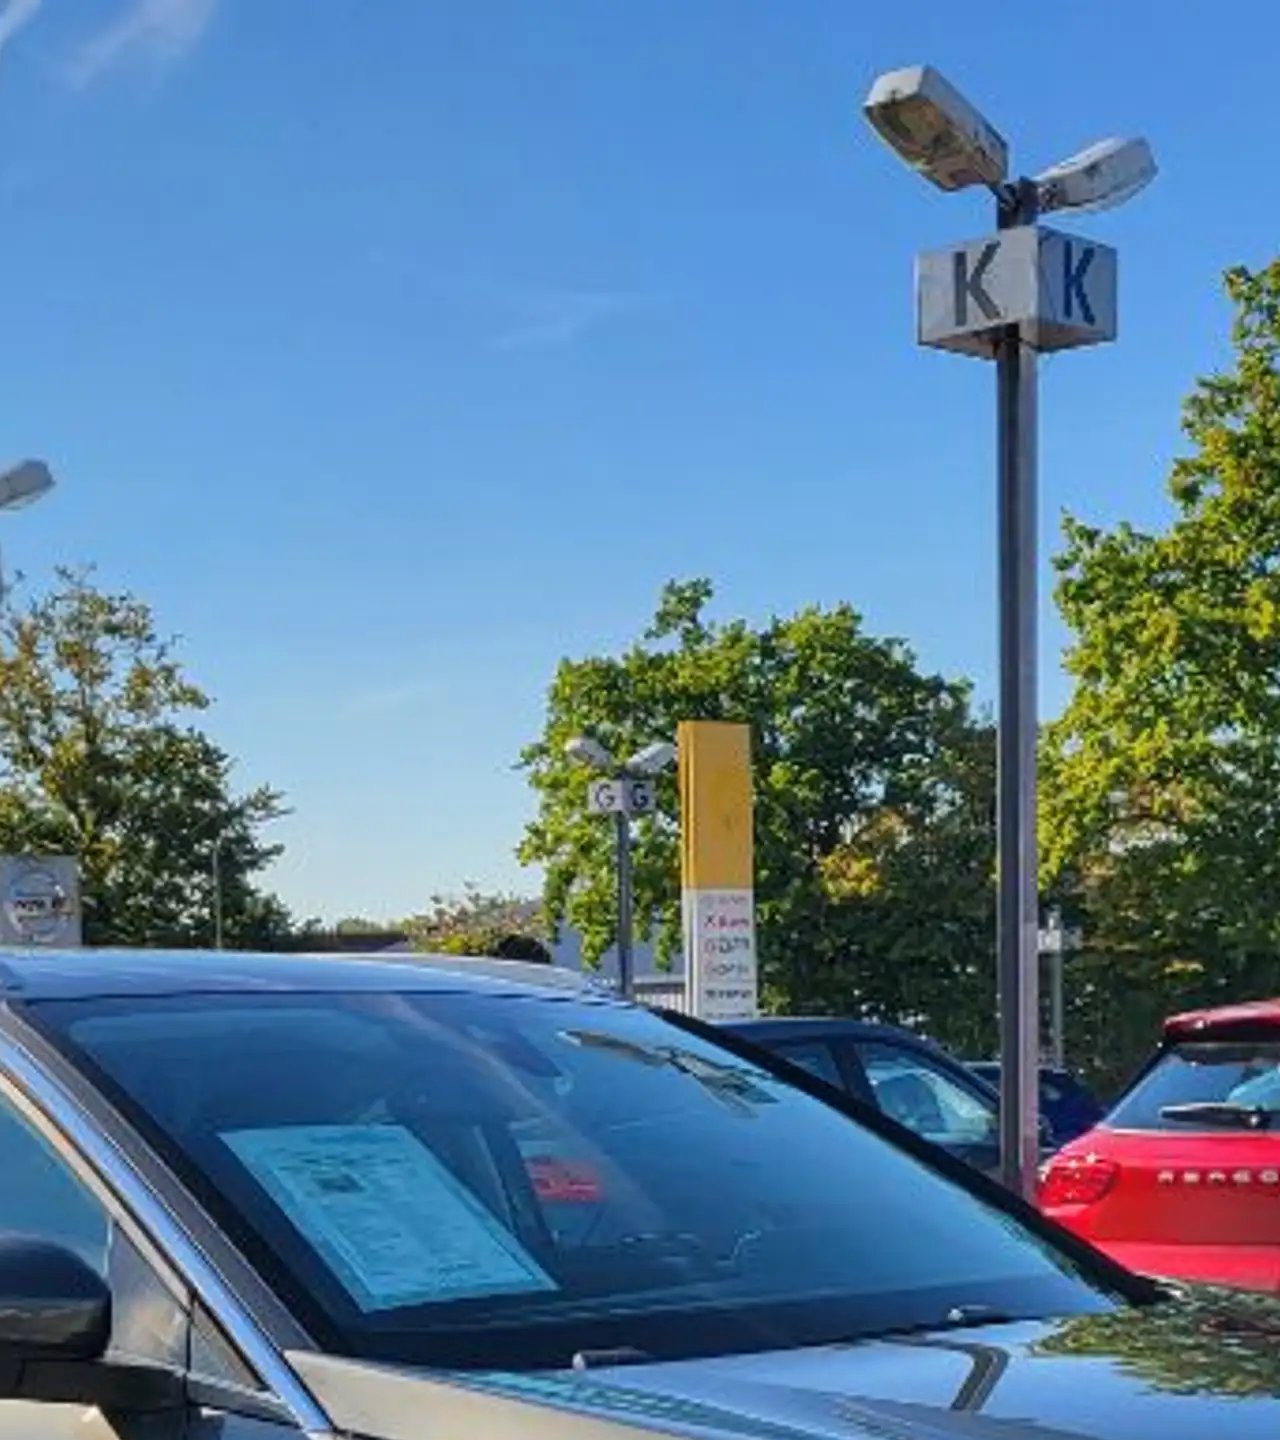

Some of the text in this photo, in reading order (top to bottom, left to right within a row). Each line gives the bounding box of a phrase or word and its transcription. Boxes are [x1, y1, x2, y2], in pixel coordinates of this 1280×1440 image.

[954, 242, 1001, 327] K
[1064, 241, 1096, 327] K
[596, 784, 616, 808] G
